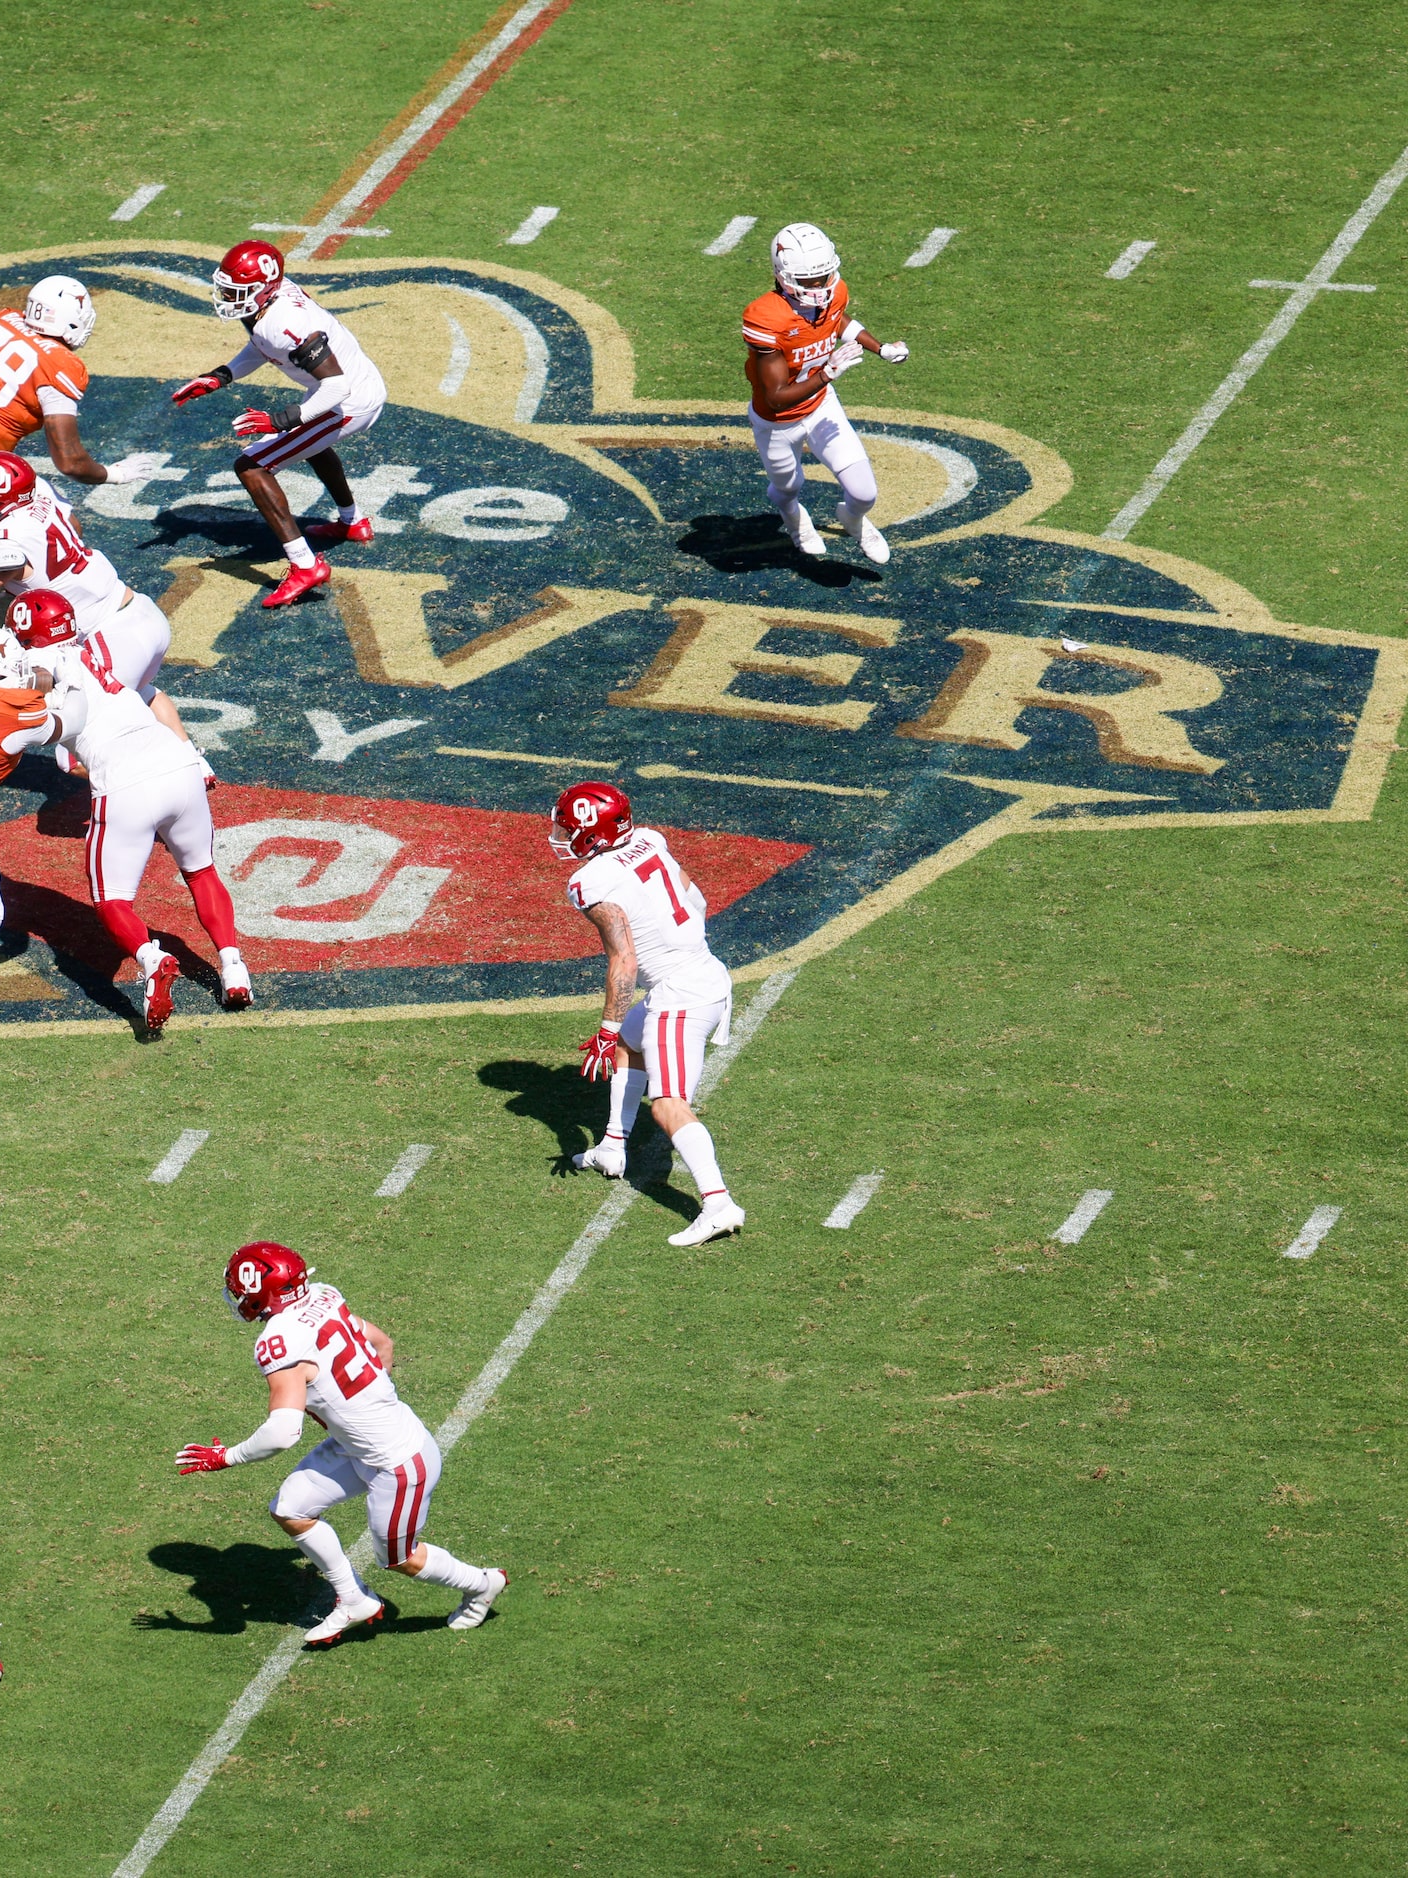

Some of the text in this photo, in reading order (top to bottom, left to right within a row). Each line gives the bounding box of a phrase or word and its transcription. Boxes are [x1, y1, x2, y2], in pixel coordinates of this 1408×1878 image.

[27, 299, 43, 320] 78
[282, 328, 302, 346] 1
[792, 331, 838, 363] TEXAS
[148, 556, 1226, 776] IVER
[613, 838, 656, 867] KANAK
[569, 881, 586, 907] 7
[634, 853, 691, 927] 7
[256, 1334, 288, 1367] 28
